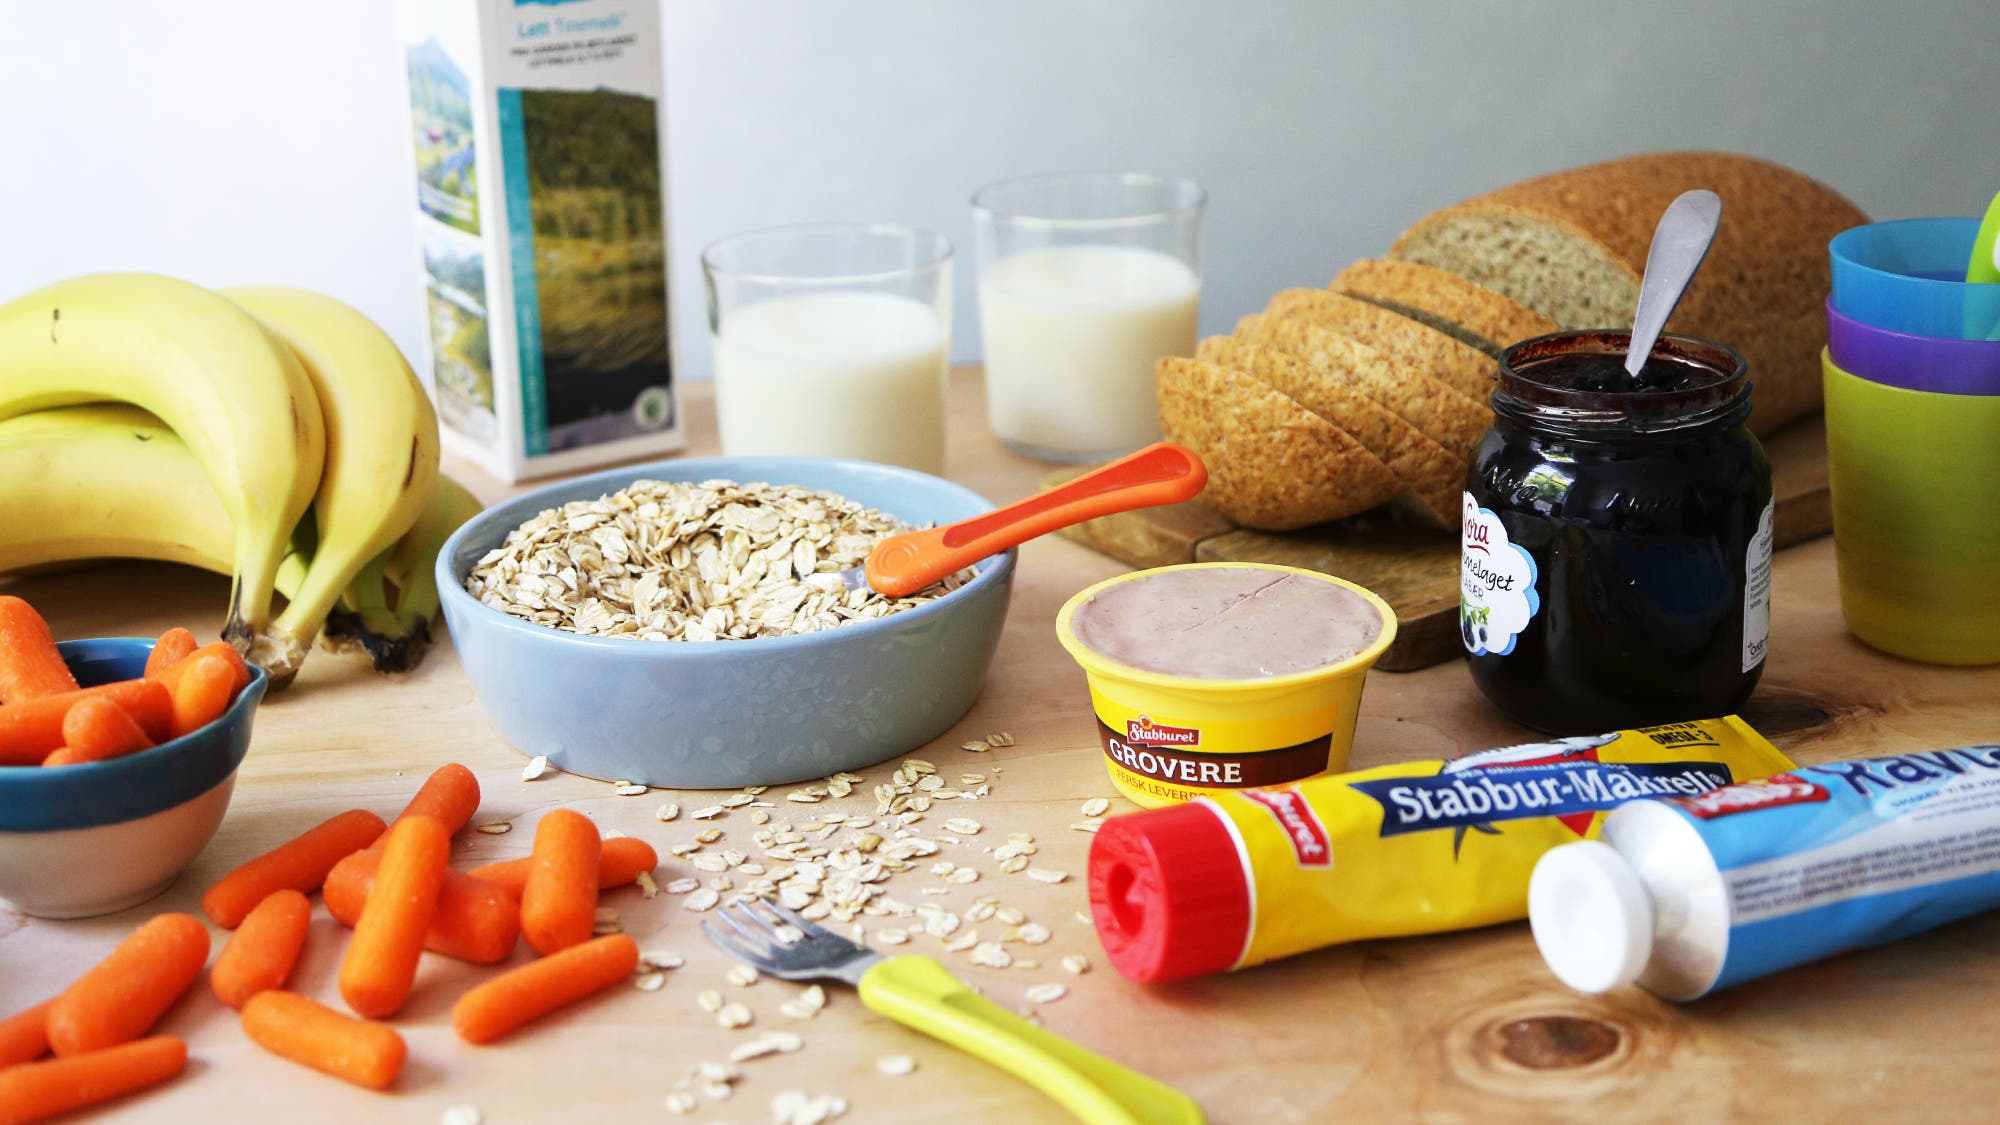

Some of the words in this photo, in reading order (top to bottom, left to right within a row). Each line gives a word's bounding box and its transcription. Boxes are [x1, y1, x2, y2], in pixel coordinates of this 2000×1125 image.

[1129, 723, 1195, 743] Stabburet
[1109, 738, 1243, 784] GROVERE
[1116, 768, 1146, 791] FERSK
